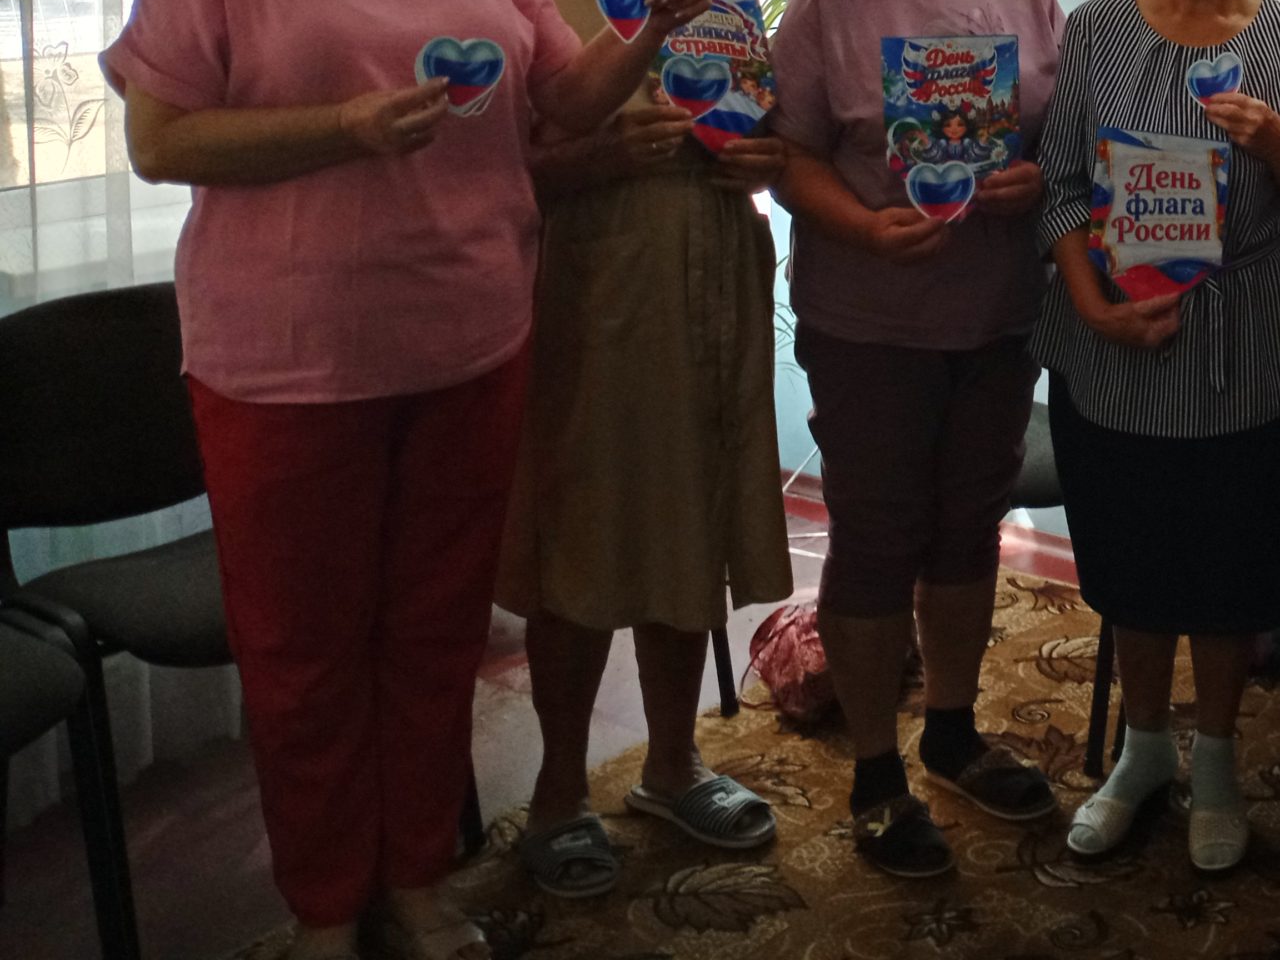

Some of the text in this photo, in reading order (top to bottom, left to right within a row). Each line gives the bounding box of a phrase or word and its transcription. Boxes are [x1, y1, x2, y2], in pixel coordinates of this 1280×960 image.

[669, 40, 749, 59] страны
[925, 48, 975, 69] День
[1124, 162, 1202, 196] День
[1125, 193, 1205, 222] флага
[1111, 216, 1212, 244] России
